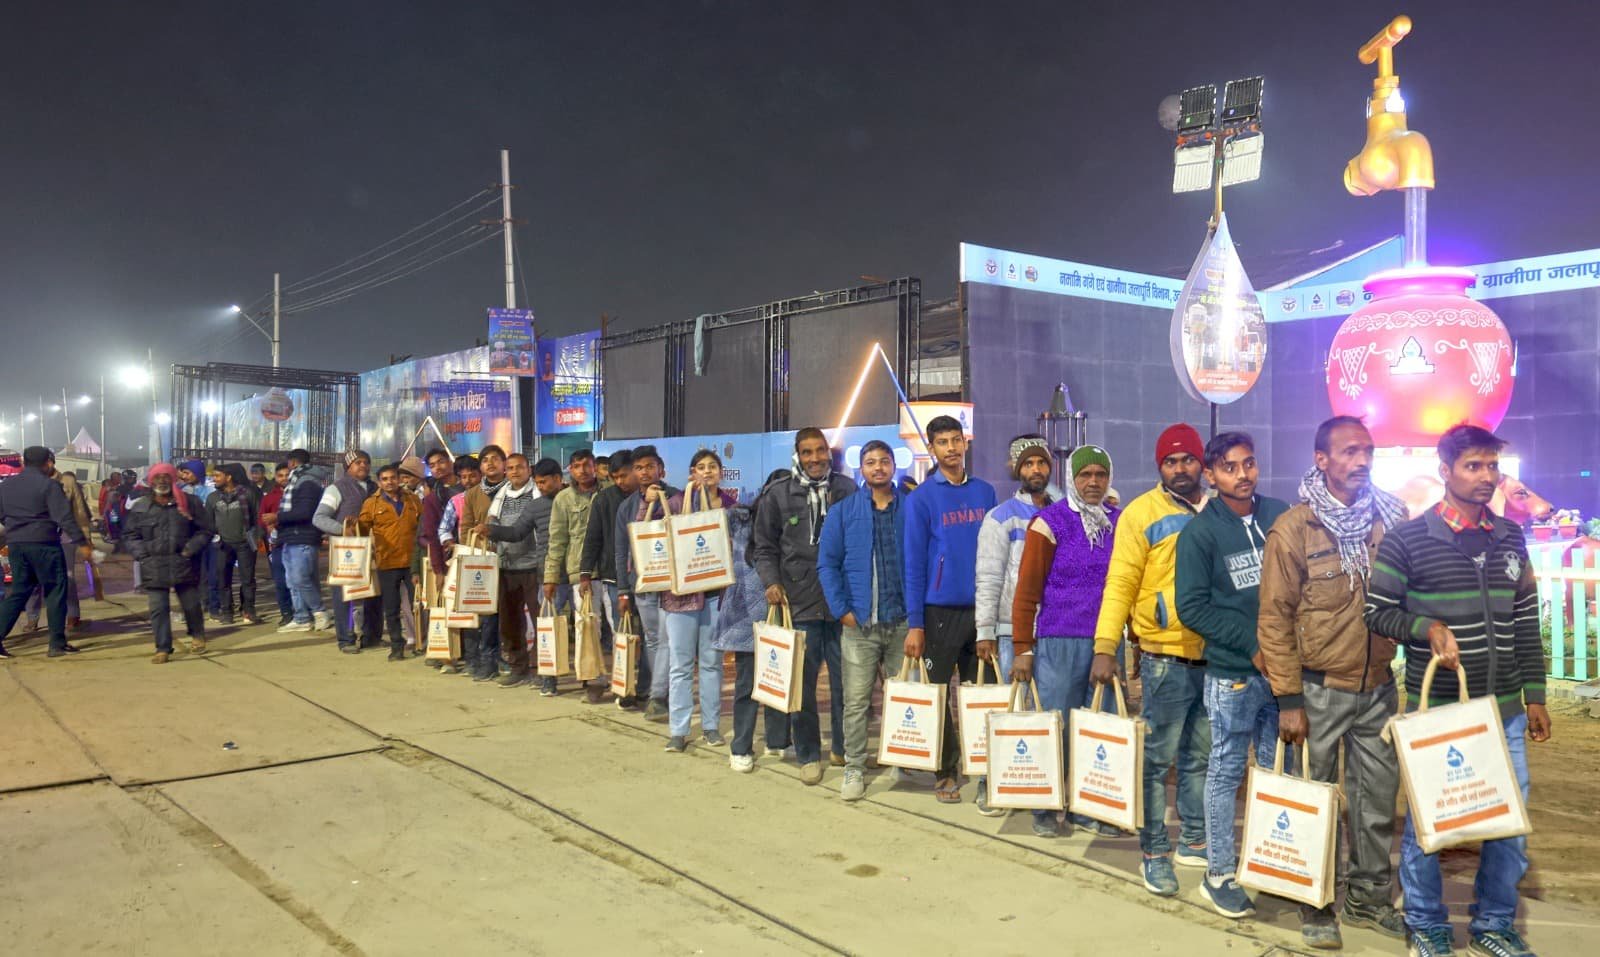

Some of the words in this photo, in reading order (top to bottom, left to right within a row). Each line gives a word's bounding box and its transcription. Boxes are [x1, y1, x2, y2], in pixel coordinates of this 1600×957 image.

[1059, 270, 1081, 288] नमामि
[1083, 272, 1095, 290] गंगे
[1096, 277, 1105, 291] एवं
[1106, 277, 1127, 295] ग्रामीण
[1482, 267, 1542, 288] ग्रामीण
[1547, 261, 1600, 279] जलापू
[467, 390, 486, 410] मिशन
